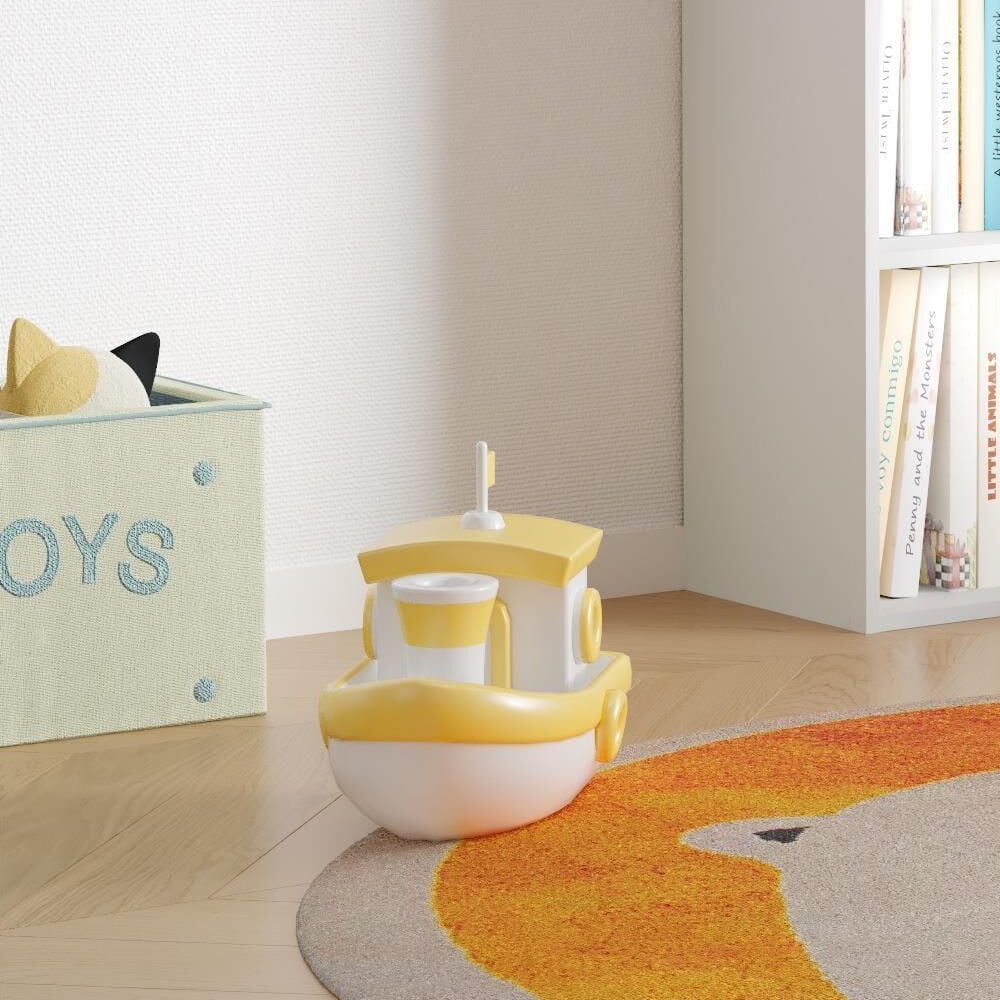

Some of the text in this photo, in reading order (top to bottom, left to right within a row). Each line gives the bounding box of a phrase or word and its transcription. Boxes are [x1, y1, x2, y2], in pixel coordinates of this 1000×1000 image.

[882, 339, 903, 443] conmigo
[905, 310, 937, 556] Penny and the Monsters
[987, 352, 997, 501] LITTLE ANIMALS
